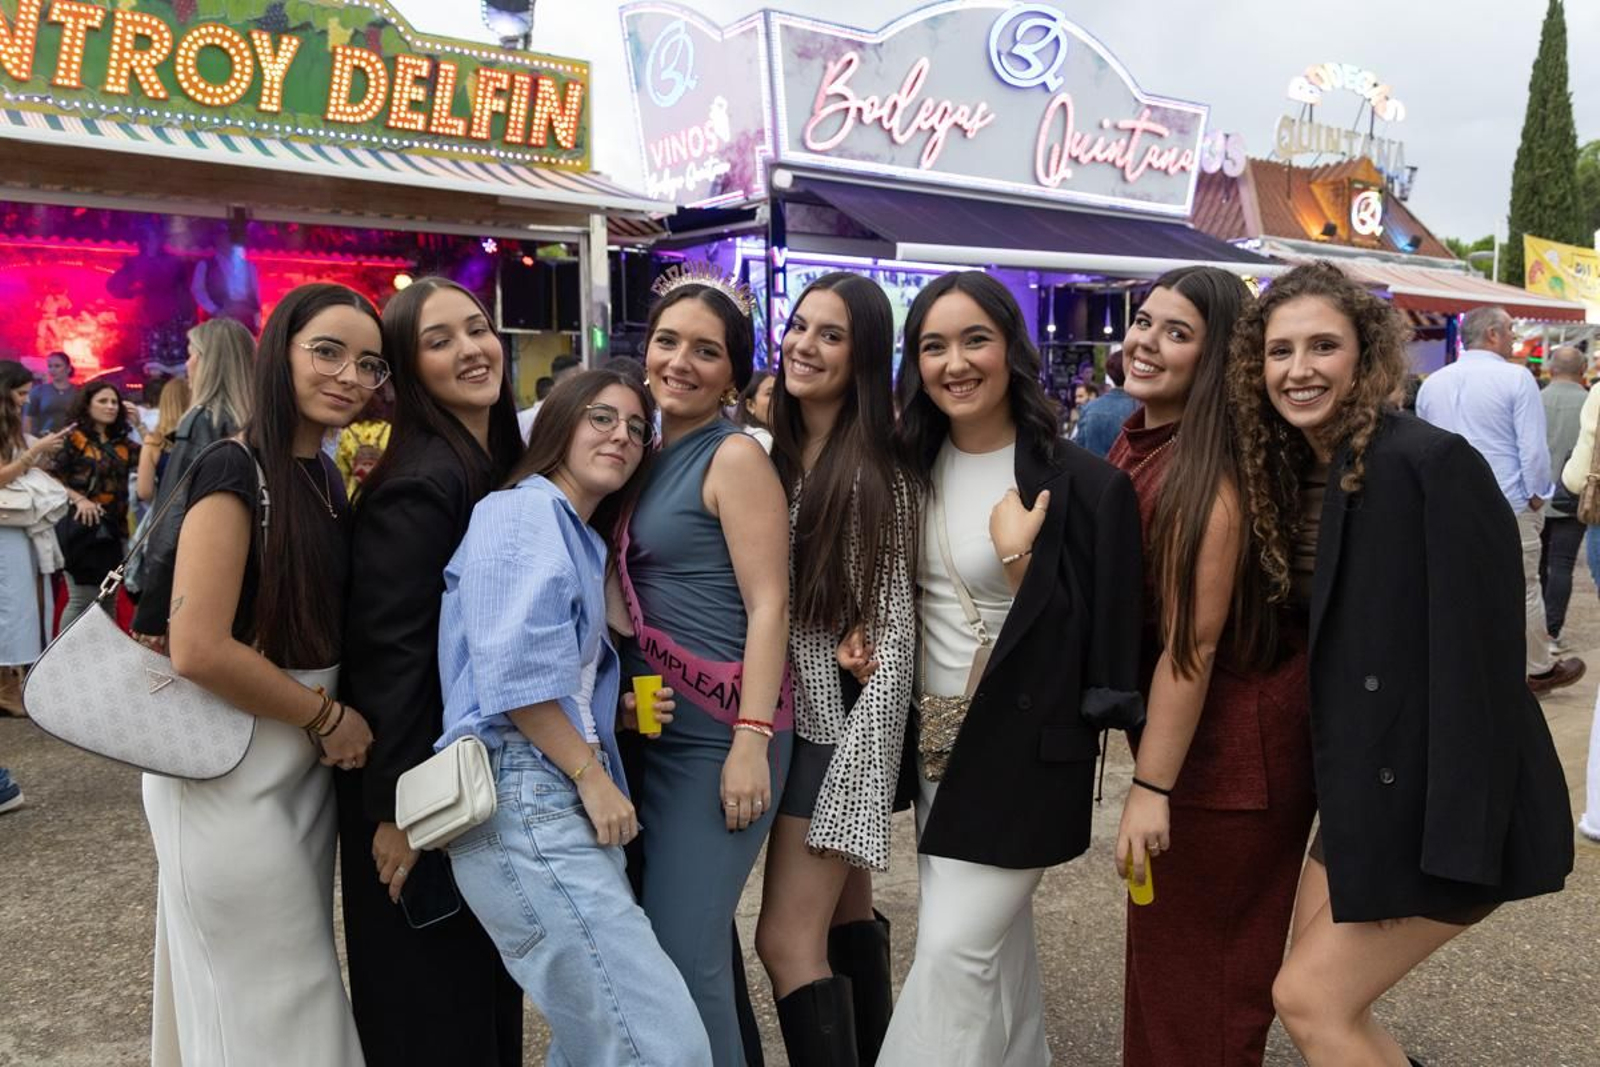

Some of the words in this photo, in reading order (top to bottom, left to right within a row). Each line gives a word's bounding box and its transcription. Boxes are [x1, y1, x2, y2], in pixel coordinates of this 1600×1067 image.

[323, 44, 584, 149] DELFIN
[650, 120, 719, 170] VINOS
[805, 51, 996, 169] Bodegas
[1036, 92, 1195, 188] Quintana
